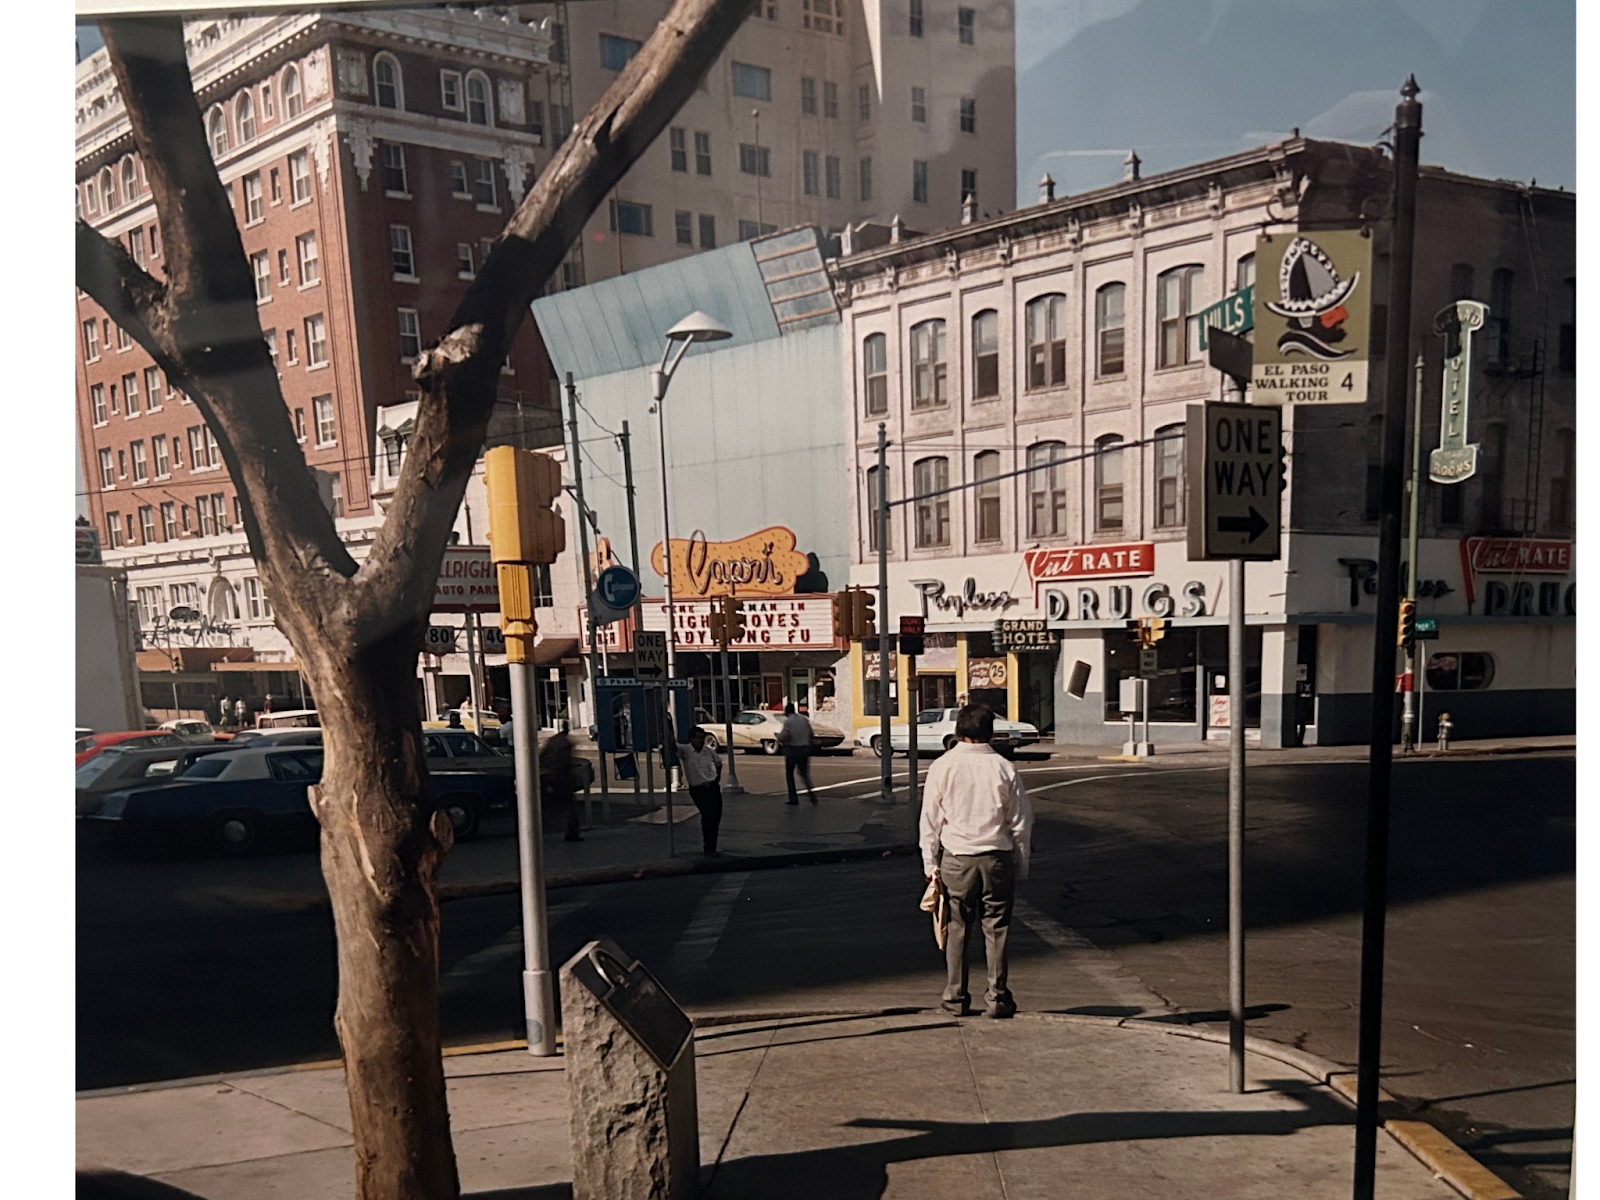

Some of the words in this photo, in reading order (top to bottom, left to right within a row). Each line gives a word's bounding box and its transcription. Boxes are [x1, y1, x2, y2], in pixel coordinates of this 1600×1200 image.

[1203, 296, 1245, 343] MILLS
[1265, 365, 1284, 376] EL
[1291, 364, 1330, 375] PASO
[1254, 377, 1329, 389] WALKING
[1340, 372, 1354, 392] 4
[1285, 390, 1329, 401] TOUR
[1215, 416, 1272, 454] ONE
[1214, 460, 1273, 496] WAY
[686, 529, 783, 595] Capri
[1029, 546, 1079, 579] Cut
[1081, 549, 1142, 571] RATE
[1518, 546, 1567, 565] RATE
[908, 577, 1018, 618] Payless
[1044, 580, 1207, 621] DRUGS
[790, 602, 805, 612] IN
[742, 613, 801, 629] OVES
[1002, 620, 1045, 631] GRAND
[637, 634, 662, 647] ONE
[672, 630, 707, 644] ADY
[787, 629, 811, 643] FU
[1002, 632, 1057, 645] HOTEL
[637, 651, 663, 663] WAY
